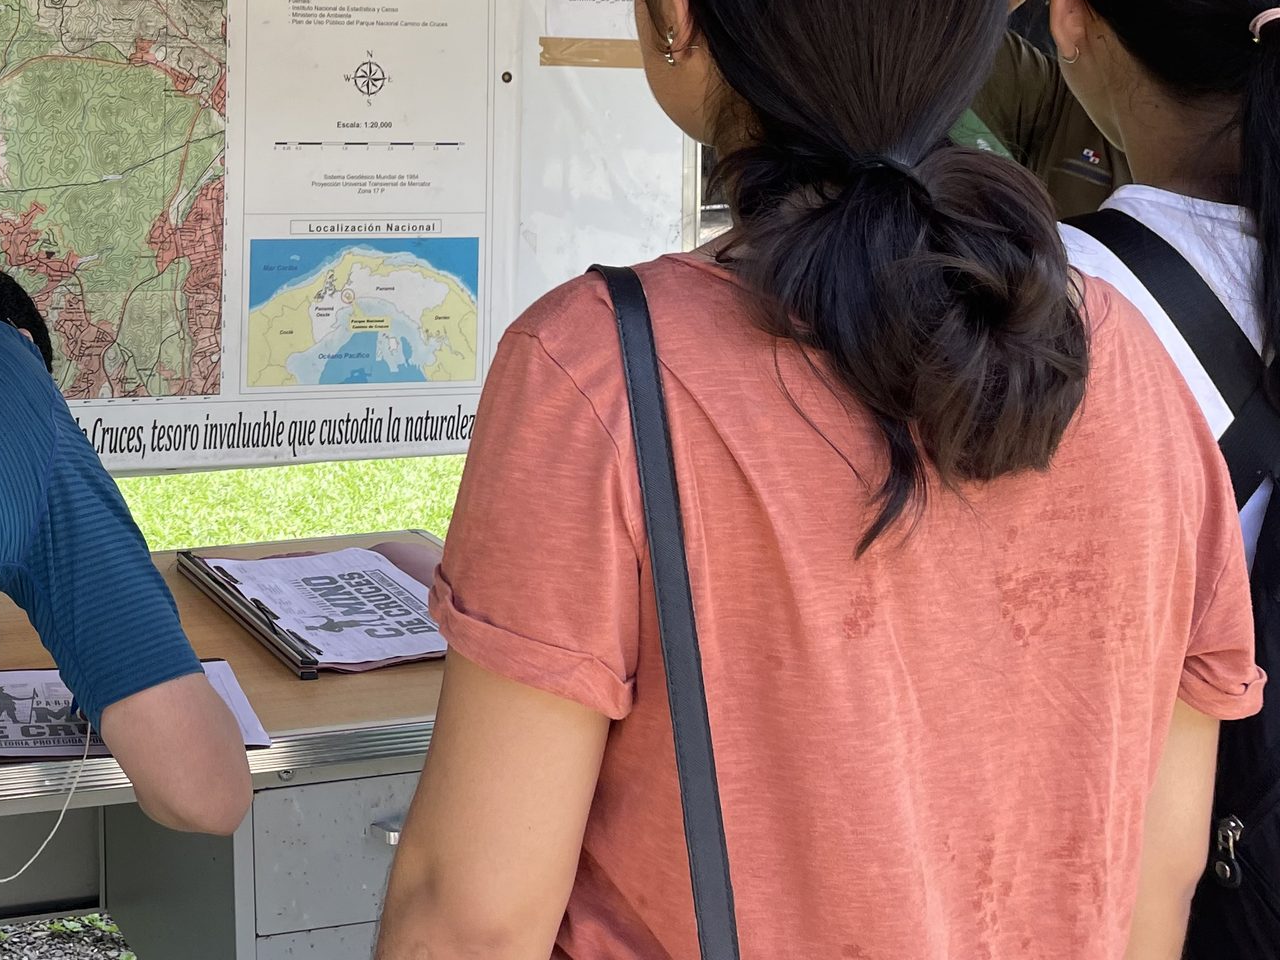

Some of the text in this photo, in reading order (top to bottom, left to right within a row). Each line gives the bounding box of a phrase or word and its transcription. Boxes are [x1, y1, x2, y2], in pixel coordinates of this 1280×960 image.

[367, 50, 373, 58] N
[344, 74, 351, 82] W
[309, 223, 435, 232] Localización Nacional
[92, 418, 146, 459] Cruces,
[151, 419, 199, 451] tesoro
[203, 410, 285, 450] invaluable
[288, 420, 315, 456] que
[320, 408, 383, 445] custodia
[386, 407, 400, 443] la
[338, 572, 412, 618] CRUCES
[394, 618, 437, 634] DE
